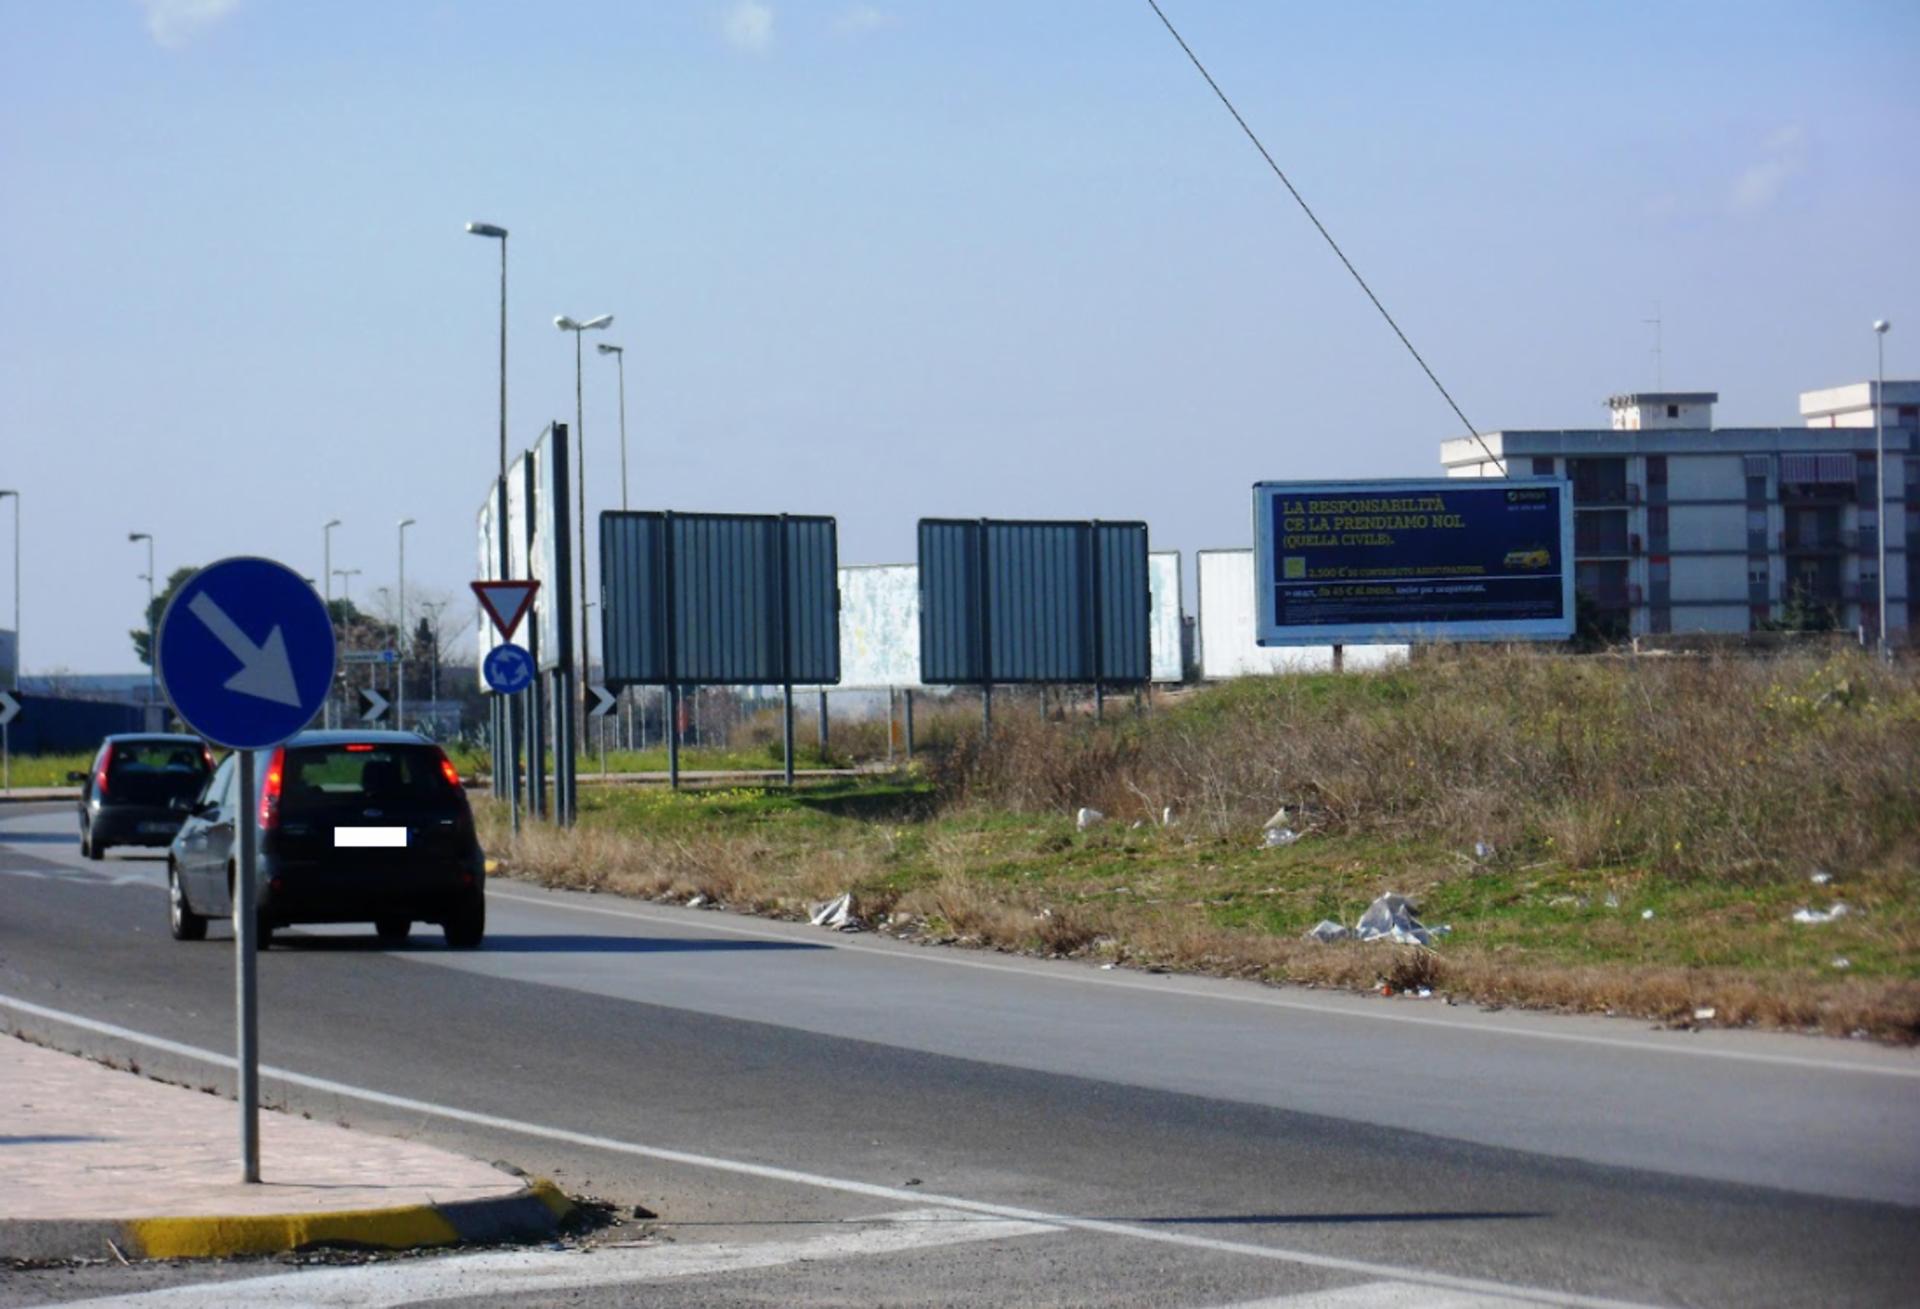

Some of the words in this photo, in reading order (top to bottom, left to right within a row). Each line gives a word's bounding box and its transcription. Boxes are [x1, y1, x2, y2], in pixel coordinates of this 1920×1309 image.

[1283, 501, 1305, 514] LA
[1309, 493, 1446, 514] RESPONSABILITÀ
[1284, 518, 1306, 532] CE
[1309, 517, 1331, 531] LA
[1334, 515, 1429, 531] PRENDIAMO
[1283, 534, 1339, 549] (QUELLA
